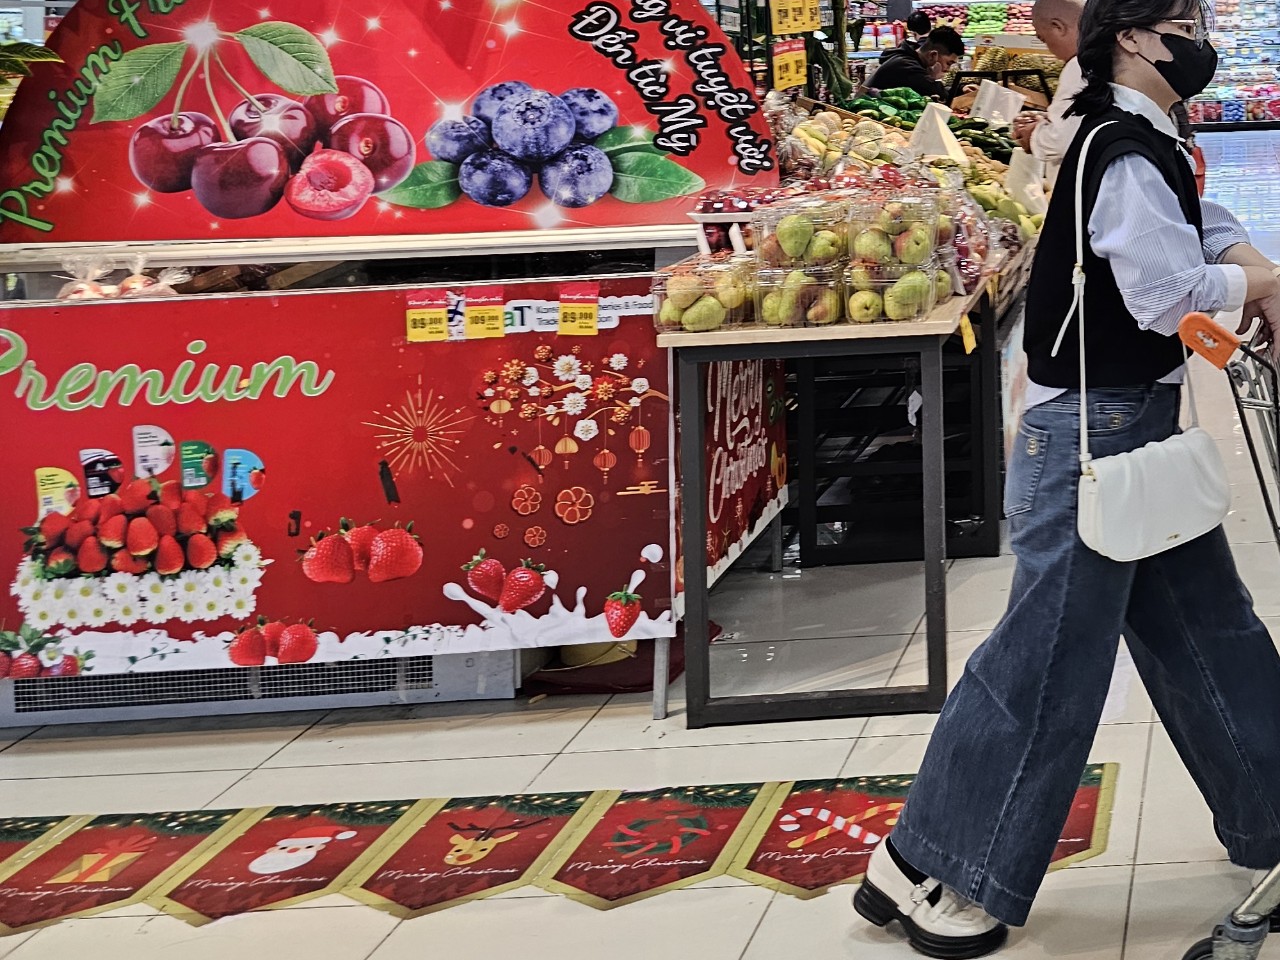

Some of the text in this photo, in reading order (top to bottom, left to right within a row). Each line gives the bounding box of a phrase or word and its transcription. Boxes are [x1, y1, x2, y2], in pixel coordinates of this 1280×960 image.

[572, 0, 633, 65] Đến
[655, 99, 705, 153] Mỹ
[661, 15, 699, 49] vị
[690, 40, 754, 128] tuyệt
[0, 38, 124, 232] Premium
[757, 847, 818, 863] Merry
[377, 864, 520, 883] Merry Christmas
[566, 857, 709, 874] Merry Christmas
[185, 873, 329, 892] Merry Christmas
